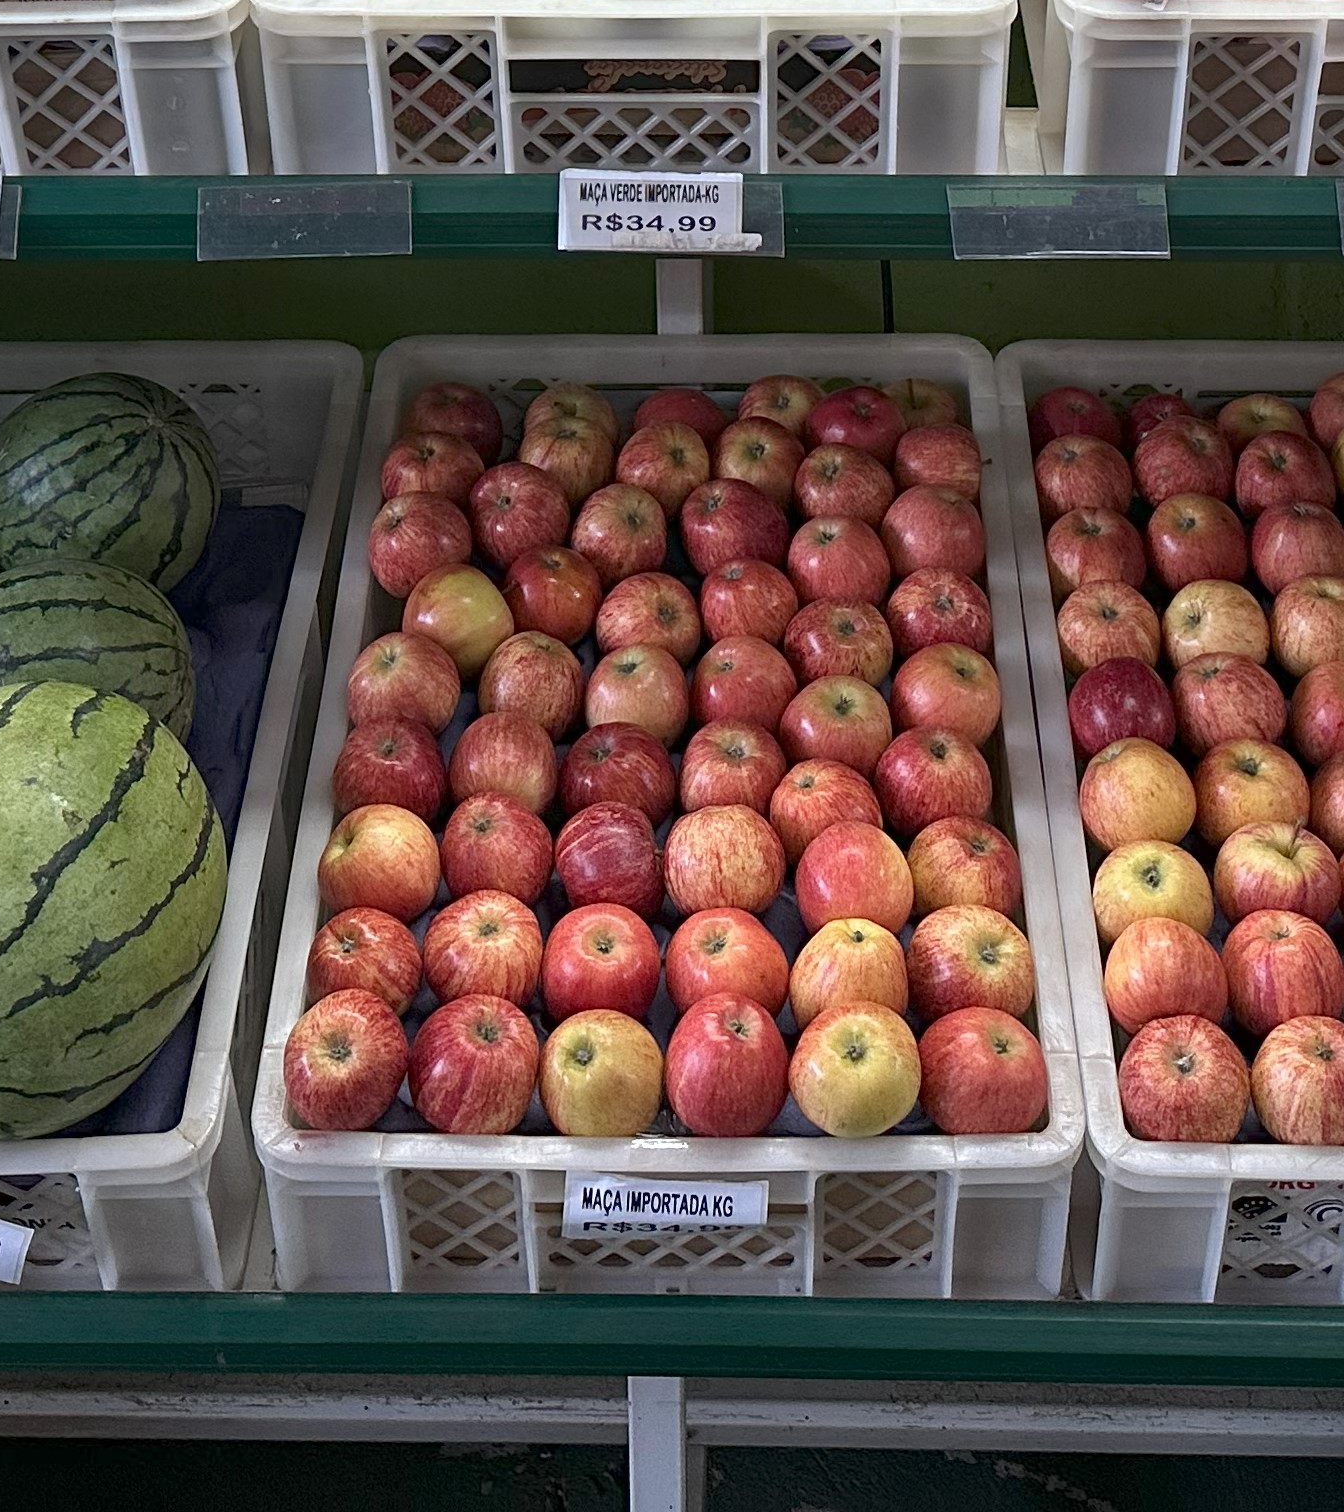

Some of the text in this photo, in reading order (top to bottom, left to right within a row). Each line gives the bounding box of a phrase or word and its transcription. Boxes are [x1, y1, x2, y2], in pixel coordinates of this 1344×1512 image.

[580, 183, 719, 206] MAÇA VERDE IMPORTADA-KG
[581, 213, 716, 233] R$34,99
[582, 1187, 733, 1217] MAÇA IMPORTADA KG
